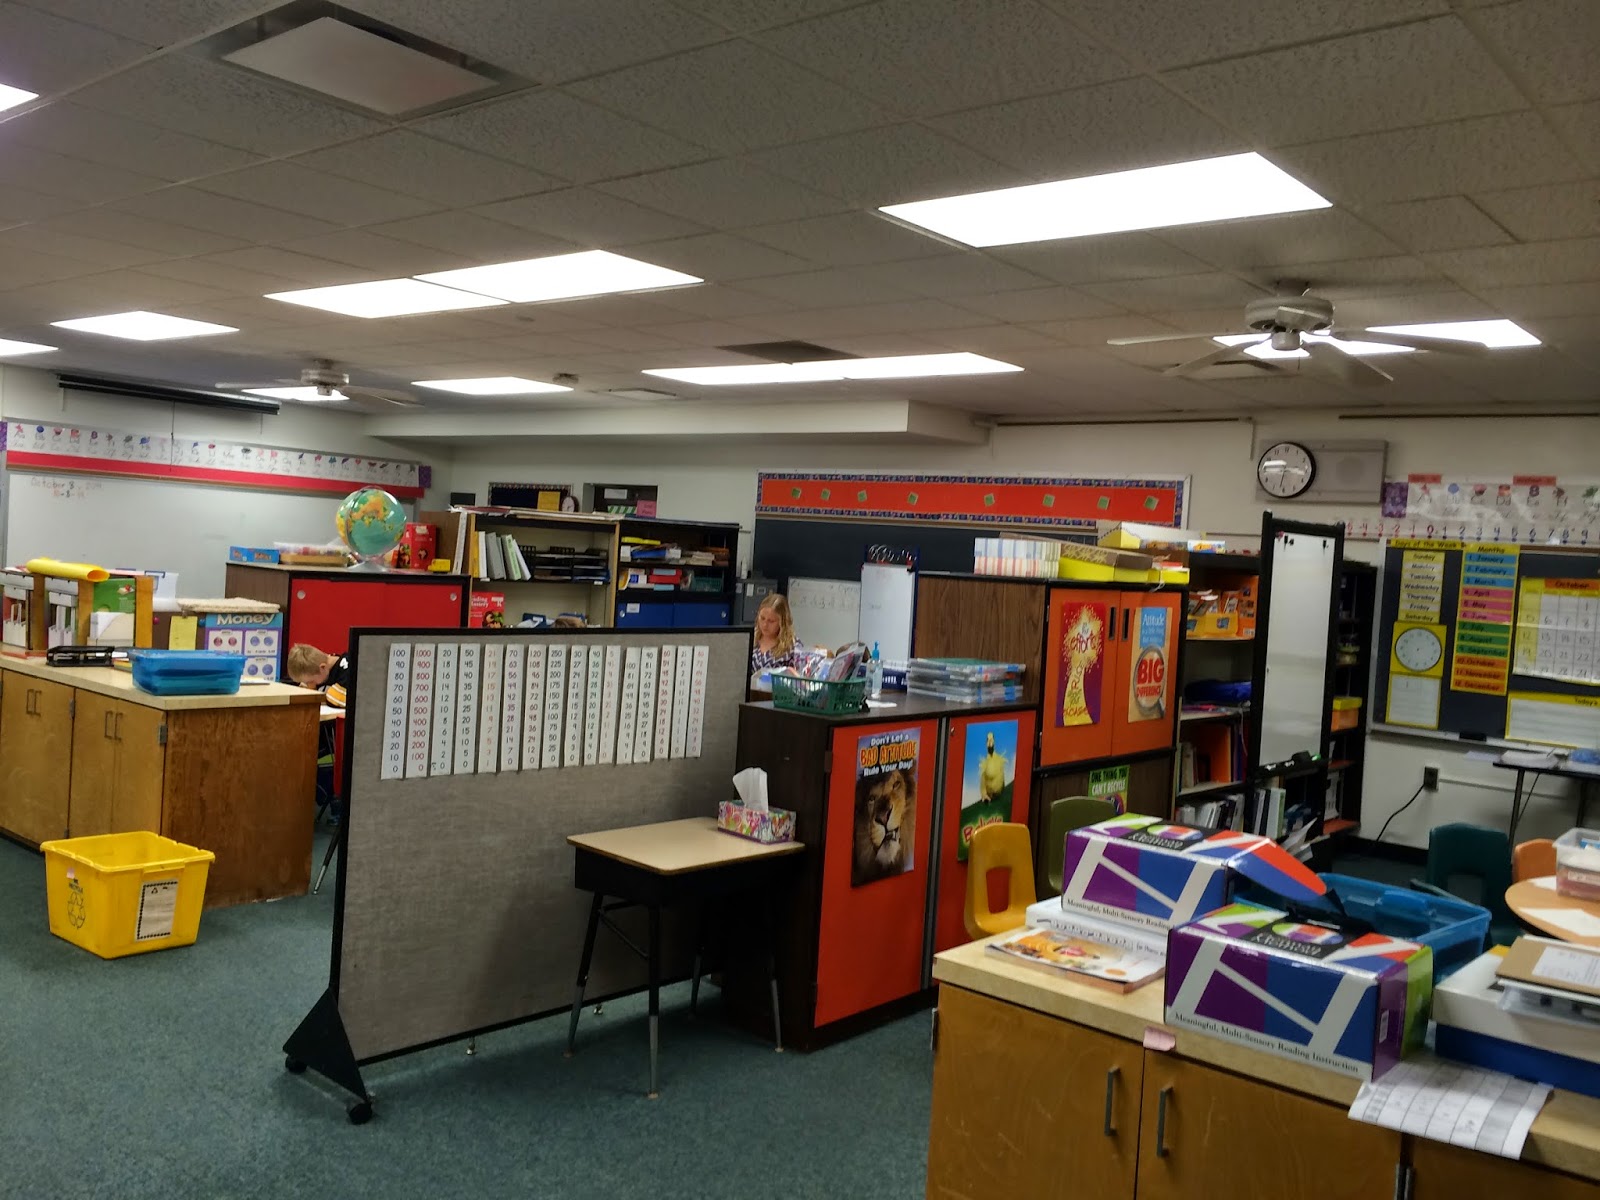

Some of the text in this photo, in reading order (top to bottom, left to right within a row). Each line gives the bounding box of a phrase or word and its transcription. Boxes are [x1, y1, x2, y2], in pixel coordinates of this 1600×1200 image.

[1478, 555, 1504, 564] January
[1475, 566, 1506, 576] February
[1410, 574, 1435, 582] Tuesday
[1404, 583, 1440, 592] Wednesday
[1407, 593, 1435, 602] Thursday
[1410, 603, 1430, 611] Friday
[217, 613, 274, 625] Money
[1405, 612, 1434, 622] Saturday
[1137, 658, 1164, 684] BIG
[393, 696, 403, 704] 60
[871, 736, 890, 746] Don't
[891, 734, 903, 742] Let
[860, 740, 917, 768] BAD ATTITUDE
[864, 760, 913, 777] Rule Your Day!
[1092, 766, 1128, 783] ONE THING YOU
[1092, 778, 1126, 796] CAN'T RECYCLE
[1067, 899, 1101, 913] Meaningful,
[1146, 917, 1170, 930] Reading
[1175, 1013, 1358, 1072] Meaningful, Multi-Sensory Reading Instruction
